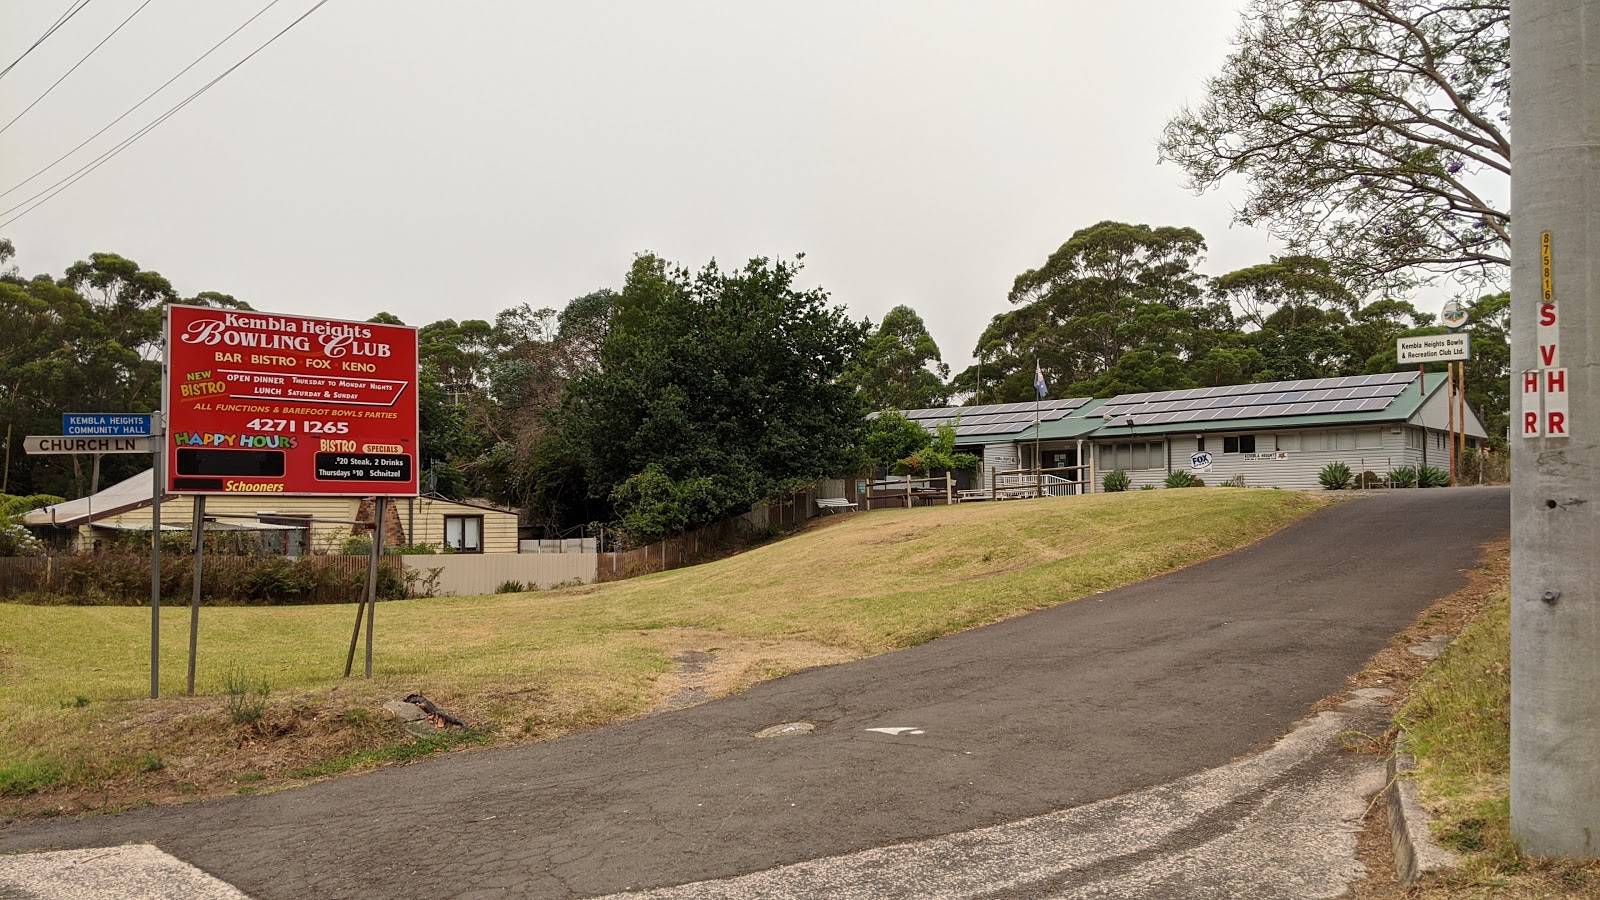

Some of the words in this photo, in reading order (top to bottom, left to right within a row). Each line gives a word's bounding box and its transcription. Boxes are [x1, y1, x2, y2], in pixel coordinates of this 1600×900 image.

[1543, 233, 1551, 300] 875816
[225, 313, 297, 332] Kembla
[302, 320, 372, 339] Heights
[1401, 342, 1422, 350] Kembla
[1424, 341, 1445, 349] Heights
[1408, 350, 1438, 359] Recreation
[1453, 347, 1464, 355] Ltd.
[215, 352, 242, 363] BAR
[251, 354, 297, 367] BISTRO
[305, 358, 331, 369] FOX
[342, 361, 376, 373] KENO
[186, 370, 212, 381] NEW
[227, 374, 251, 382] OPEN
[254, 376, 285, 385] DINNER
[181, 381, 226, 397] BISTRO
[254, 387, 282, 395] LUNCH
[193, 403, 212, 411] ALL
[216, 404, 270, 413] FUNCTIONS
[282, 407, 330, 416] BAREFOOT
[331, 409, 363, 418] BOWLS
[364, 411, 398, 419] PARTIES
[70, 417, 106, 425] KEMBLA
[110, 416, 144, 425] HEIGHTS
[246, 418, 296, 432] 4271
[304, 420, 349, 434] 1265
[68, 426, 119, 434] COMMUNITY
[123, 426, 145, 434] HALL
[39, 439, 109, 451] CHURCH
[115, 439, 135, 451] LN
[174, 432, 236, 446] HAPPY
[240, 434, 298, 449] HOURS
[320, 439, 357, 453] BISTRO
[367, 445, 399, 453] SPECIALS
[380, 458, 404, 466] Drinks
[1192, 454, 1209, 465] FOX
[318, 469, 351, 478] Thursdays
[352, 469, 364, 477] $10
[369, 469, 401, 478] Schnitzel
[225, 480, 285, 492] Schooners
